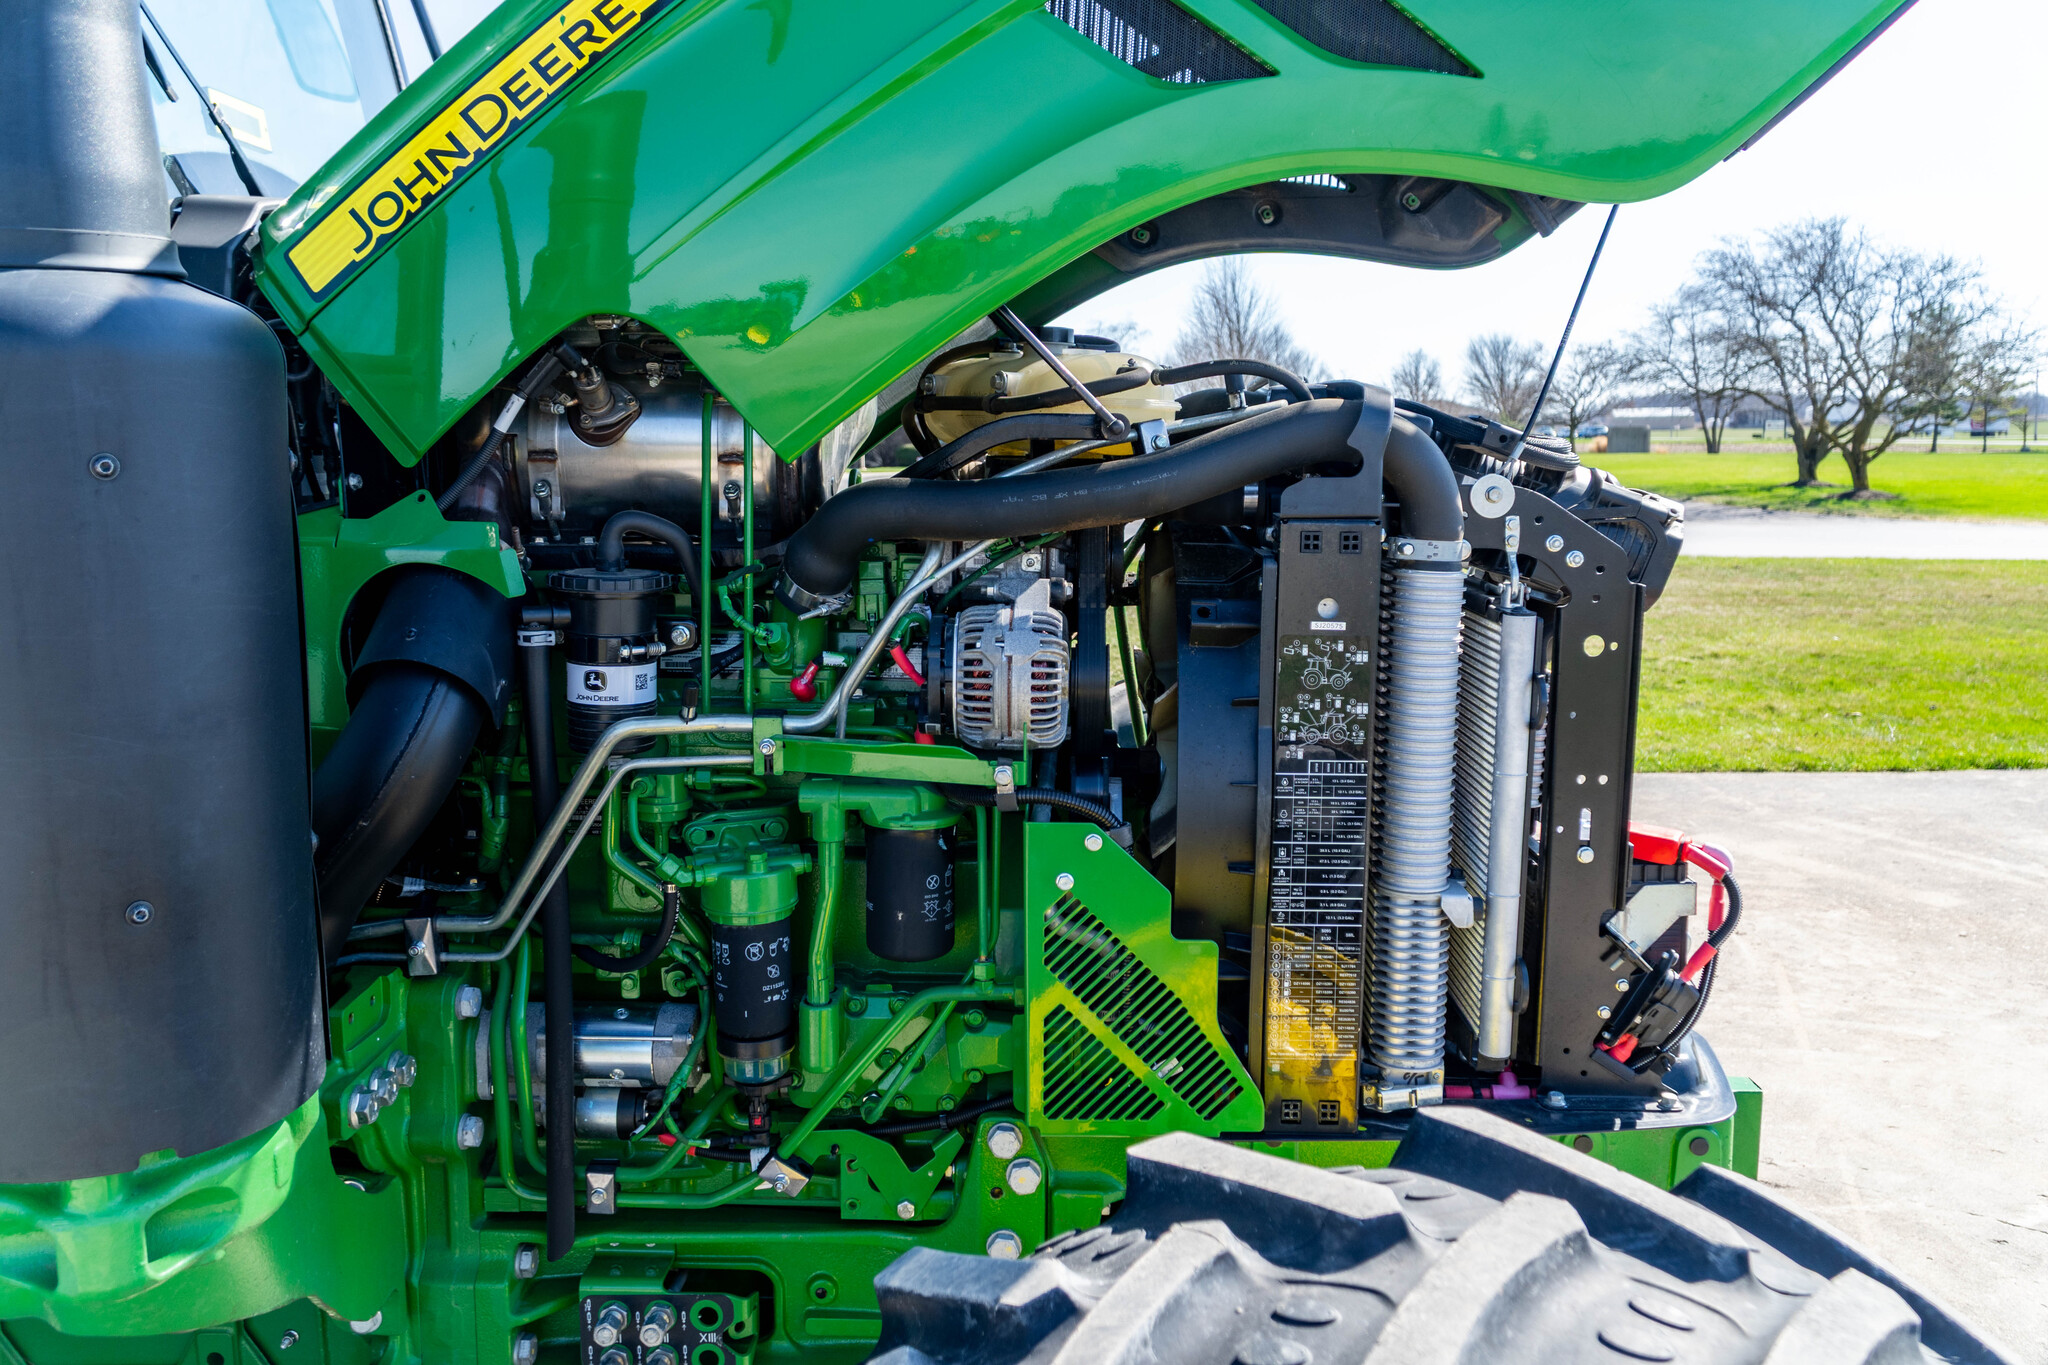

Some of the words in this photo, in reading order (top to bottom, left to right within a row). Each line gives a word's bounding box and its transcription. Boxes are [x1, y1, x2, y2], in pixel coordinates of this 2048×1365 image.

[347, 131, 472, 254] JOHN
[459, 0, 638, 142] DEERE
[576, 693, 592, 701] JOHN
[699, 1332, 716, 1343] XIII
